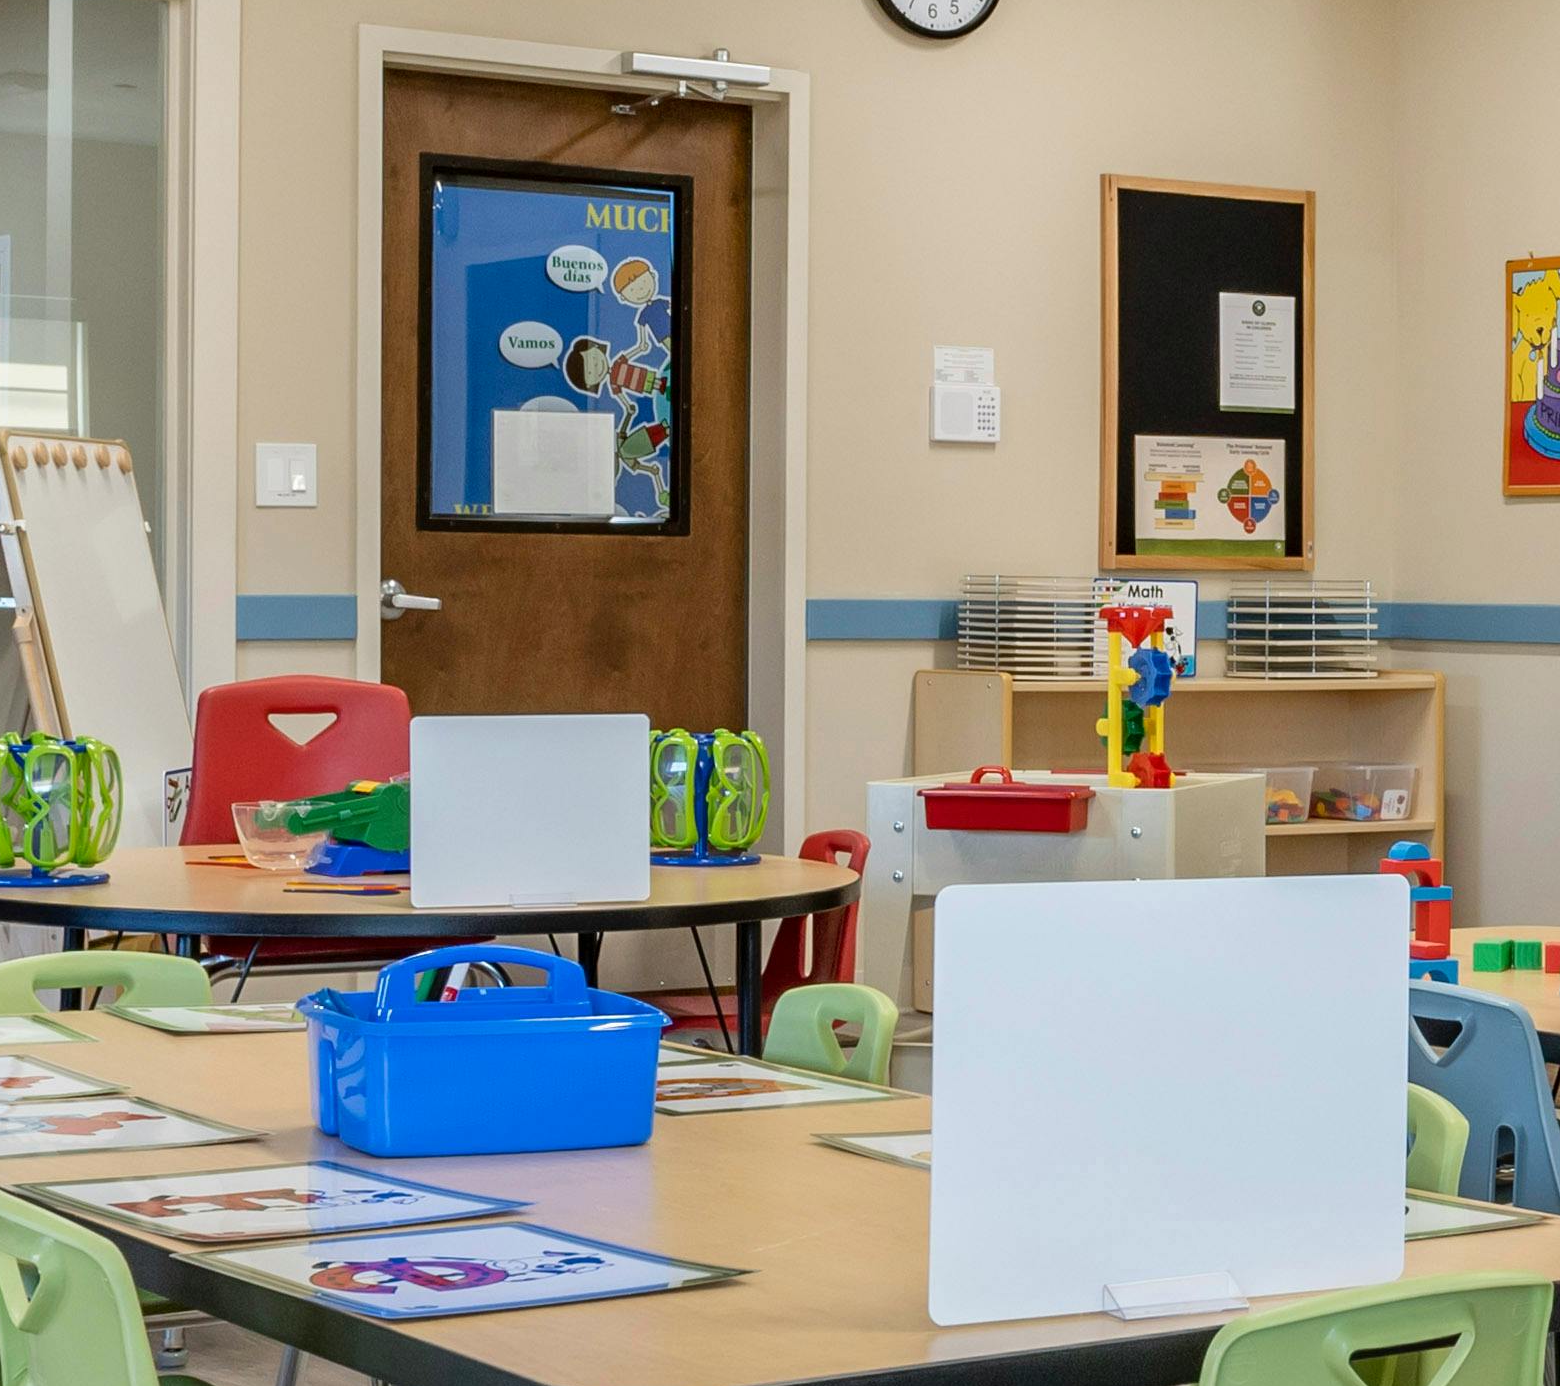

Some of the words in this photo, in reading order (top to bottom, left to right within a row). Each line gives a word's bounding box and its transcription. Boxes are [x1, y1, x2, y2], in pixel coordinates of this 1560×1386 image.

[928, 3, 937, 19] 6
[950, 0, 959, 14] 5
[552, 255, 604, 272] Buenos
[508, 336, 556, 350] Vamos
[1127, 585, 1165, 599] Math
